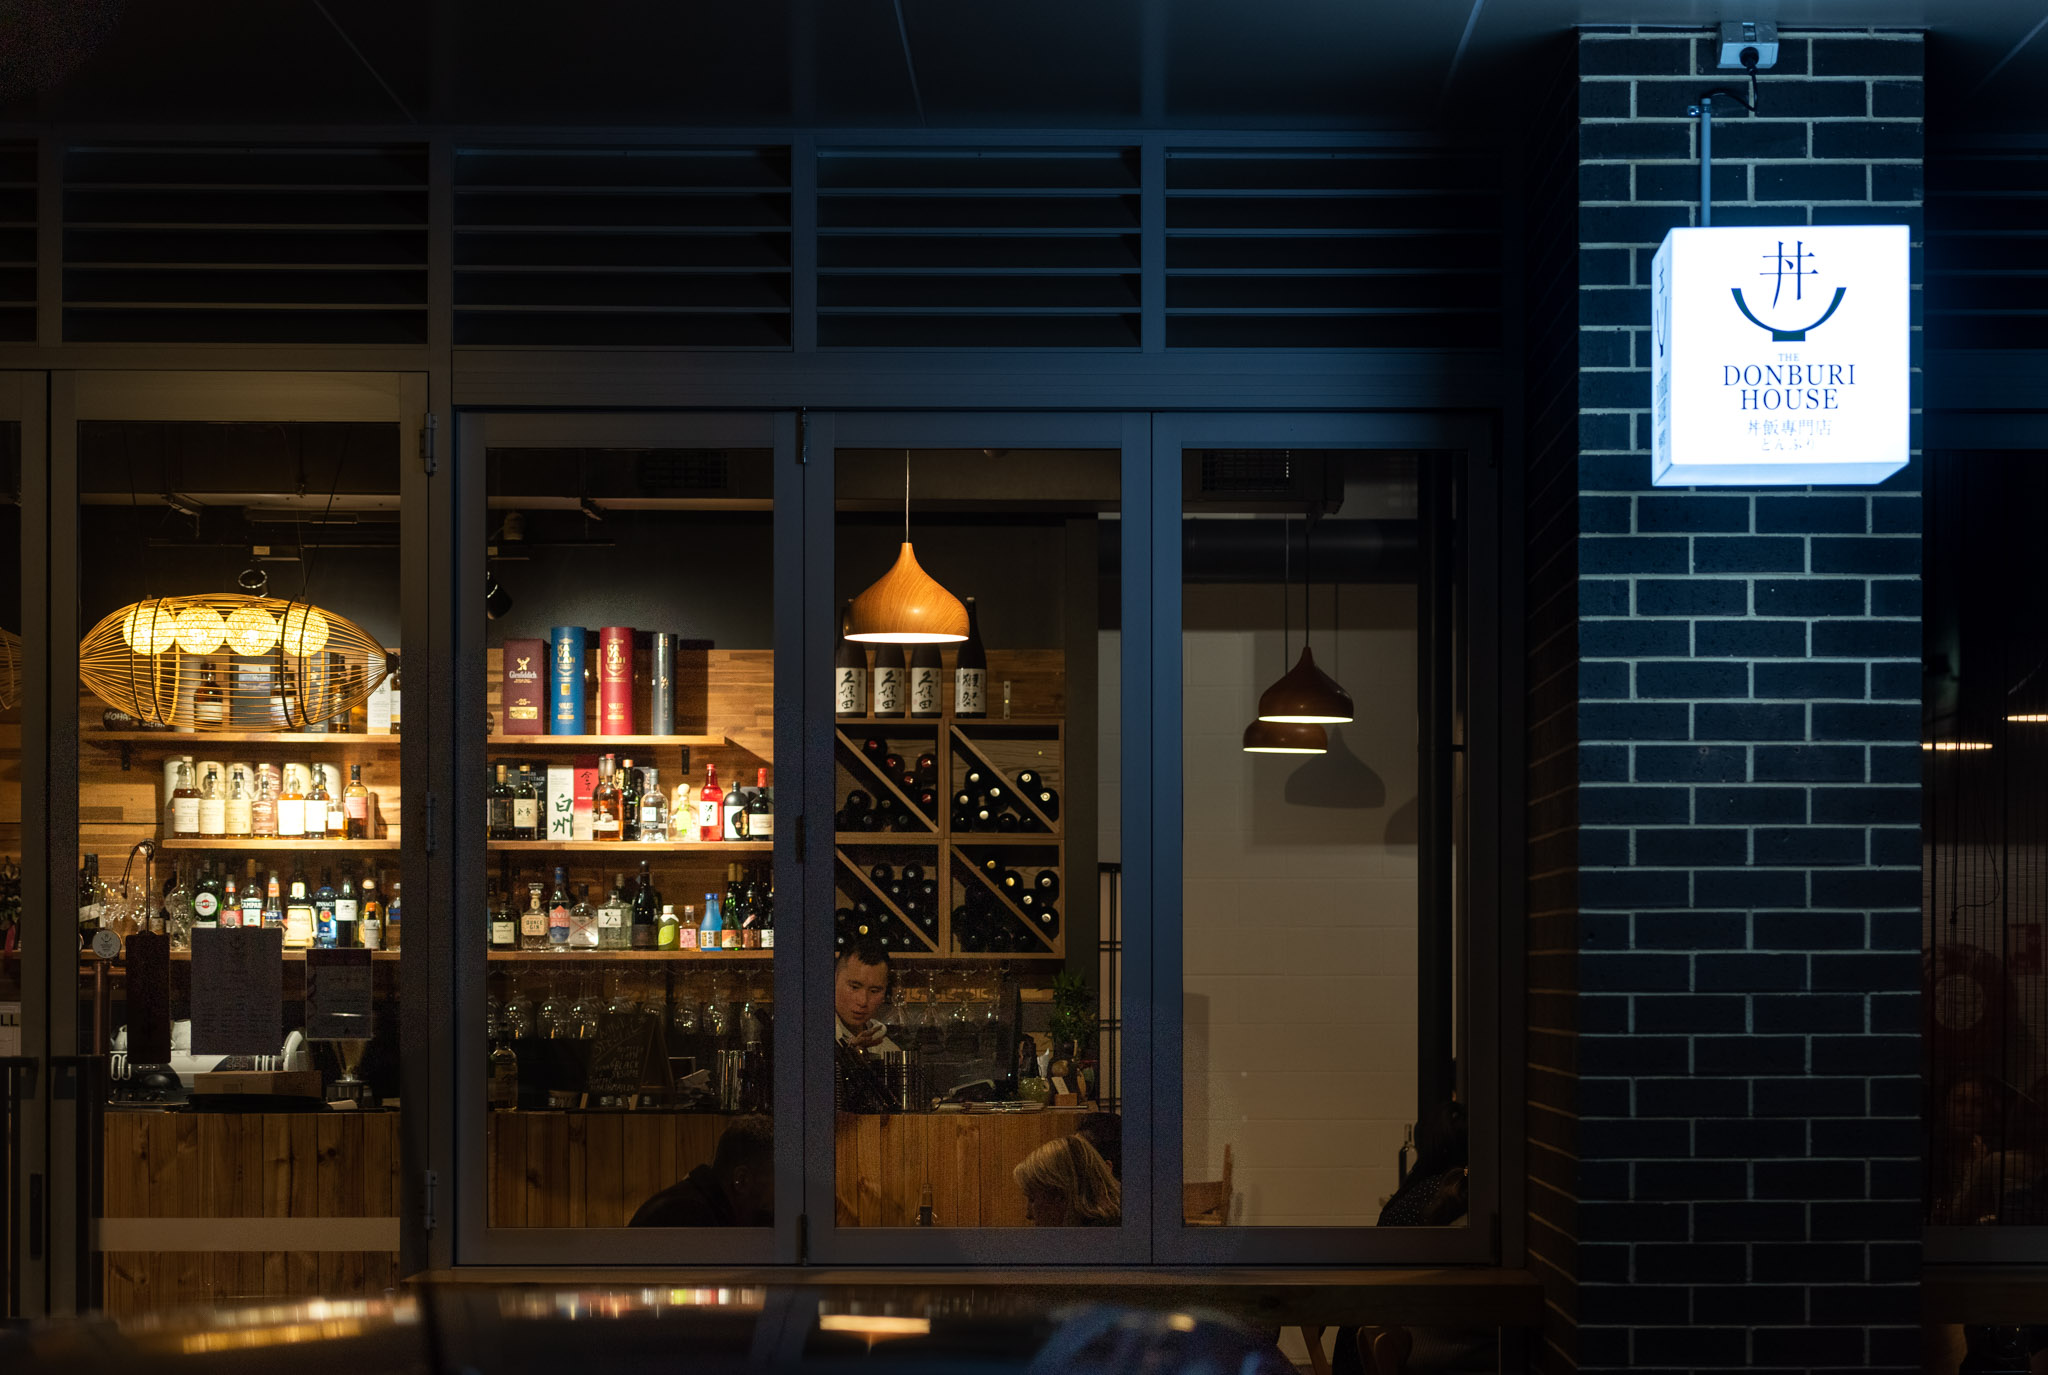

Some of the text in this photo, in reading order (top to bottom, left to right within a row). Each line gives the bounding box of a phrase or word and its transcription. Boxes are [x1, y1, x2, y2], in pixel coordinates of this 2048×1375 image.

[1759, 240, 1819, 310] 丼
[1778, 353, 1800, 362] THE
[1723, 364, 1856, 387] DONBURI
[1740, 388, 1839, 410] HOUSE
[508, 670, 538, 679] Glenfiddich
[838, 670, 856, 710] 久保田
[878, 670, 897, 710] 久保田
[915, 670, 934, 710] 久保田
[552, 793, 574, 838] 白州
[241, 901, 263, 909] CAMPARI
